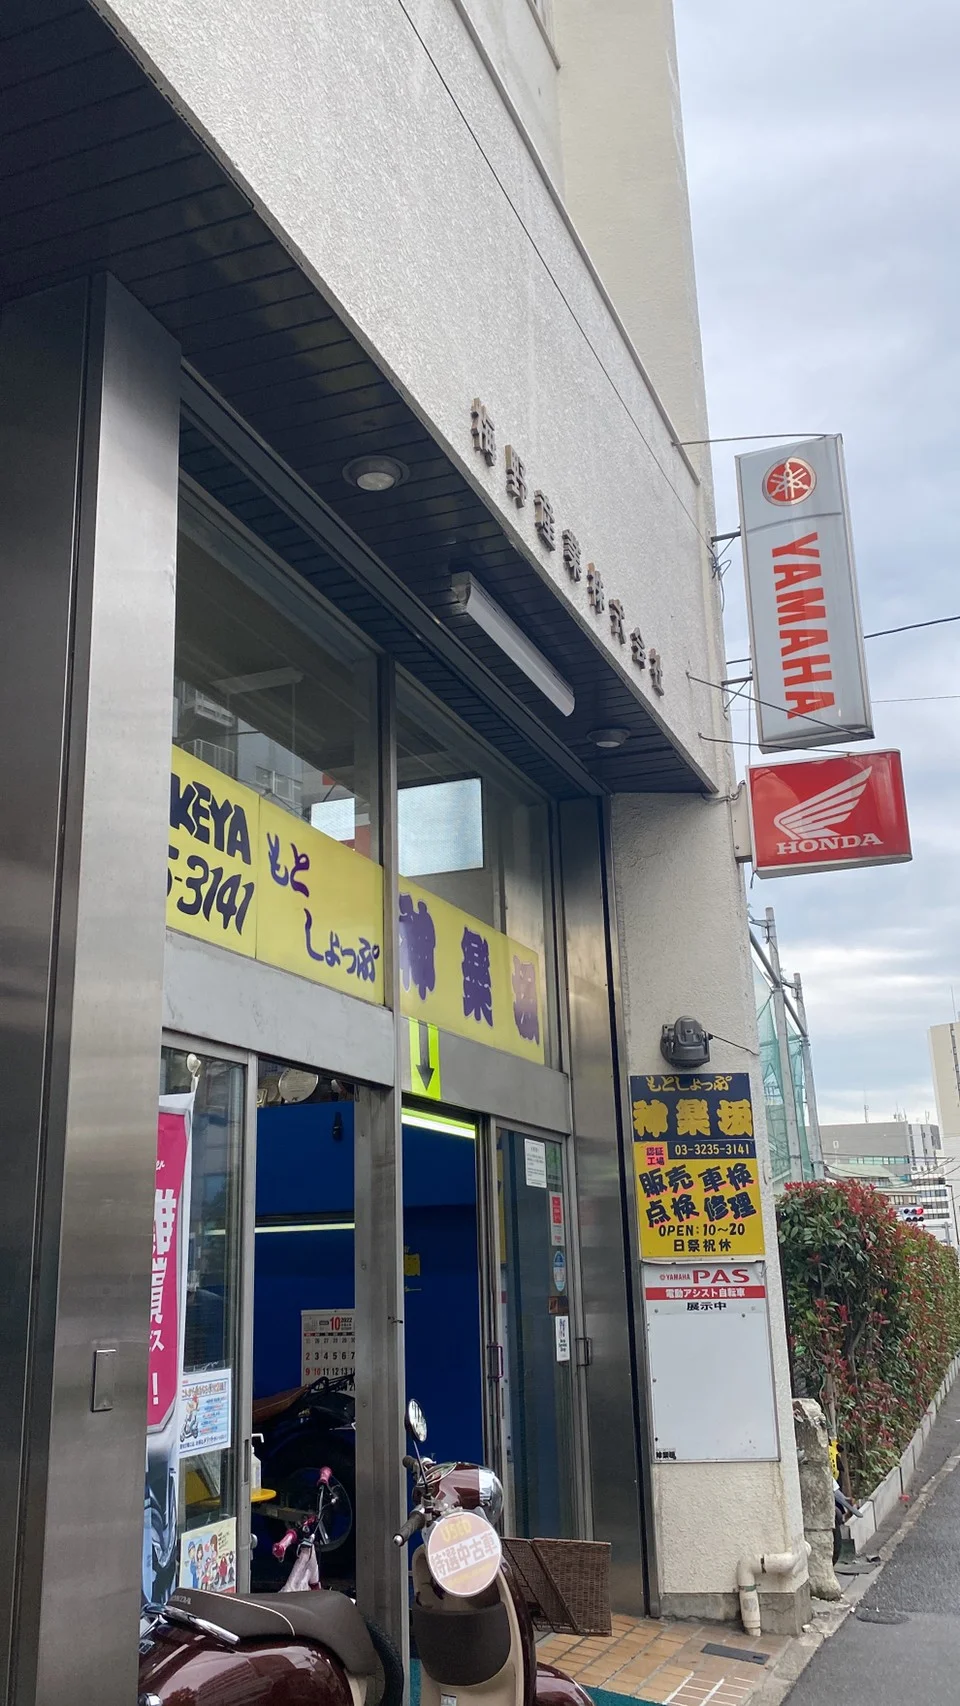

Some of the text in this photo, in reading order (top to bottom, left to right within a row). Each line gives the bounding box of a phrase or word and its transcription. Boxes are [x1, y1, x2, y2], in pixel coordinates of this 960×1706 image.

[771, 531, 836, 720] YAMAHA
[776, 833, 883, 855] HONDA
[266, 832, 310, 897] もと
[632, 1098, 754, 1138] 神楽坂
[675, 1143, 750, 1156] 03-3235-3141
[647, 1156, 665, 1166] 工場
[638, 1162, 755, 1197] 販売 車検
[646, 1191, 757, 1228] 点検 修理
[693, 1269, 750, 1284] PAS
[665, 1287, 745, 1298] 電動アシスト自転車
[686, 1301, 727, 1311] 展示中
[330, 1317, 340, 1331] 10
[305, 1352, 310, 1361] 2
[315, 1352, 320, 1361] 3
[324, 1352, 328, 1361] 4
[333, 1352, 337, 1361] 5
[342, 1352, 346, 1360] 6
[305, 1368, 310, 1376] 9
[314, 1368, 321, 1376] 10
[323, 1367, 329, 1376] 11
[332, 1367, 339, 1376] 12
[341, 1367, 348, 1376] 13
